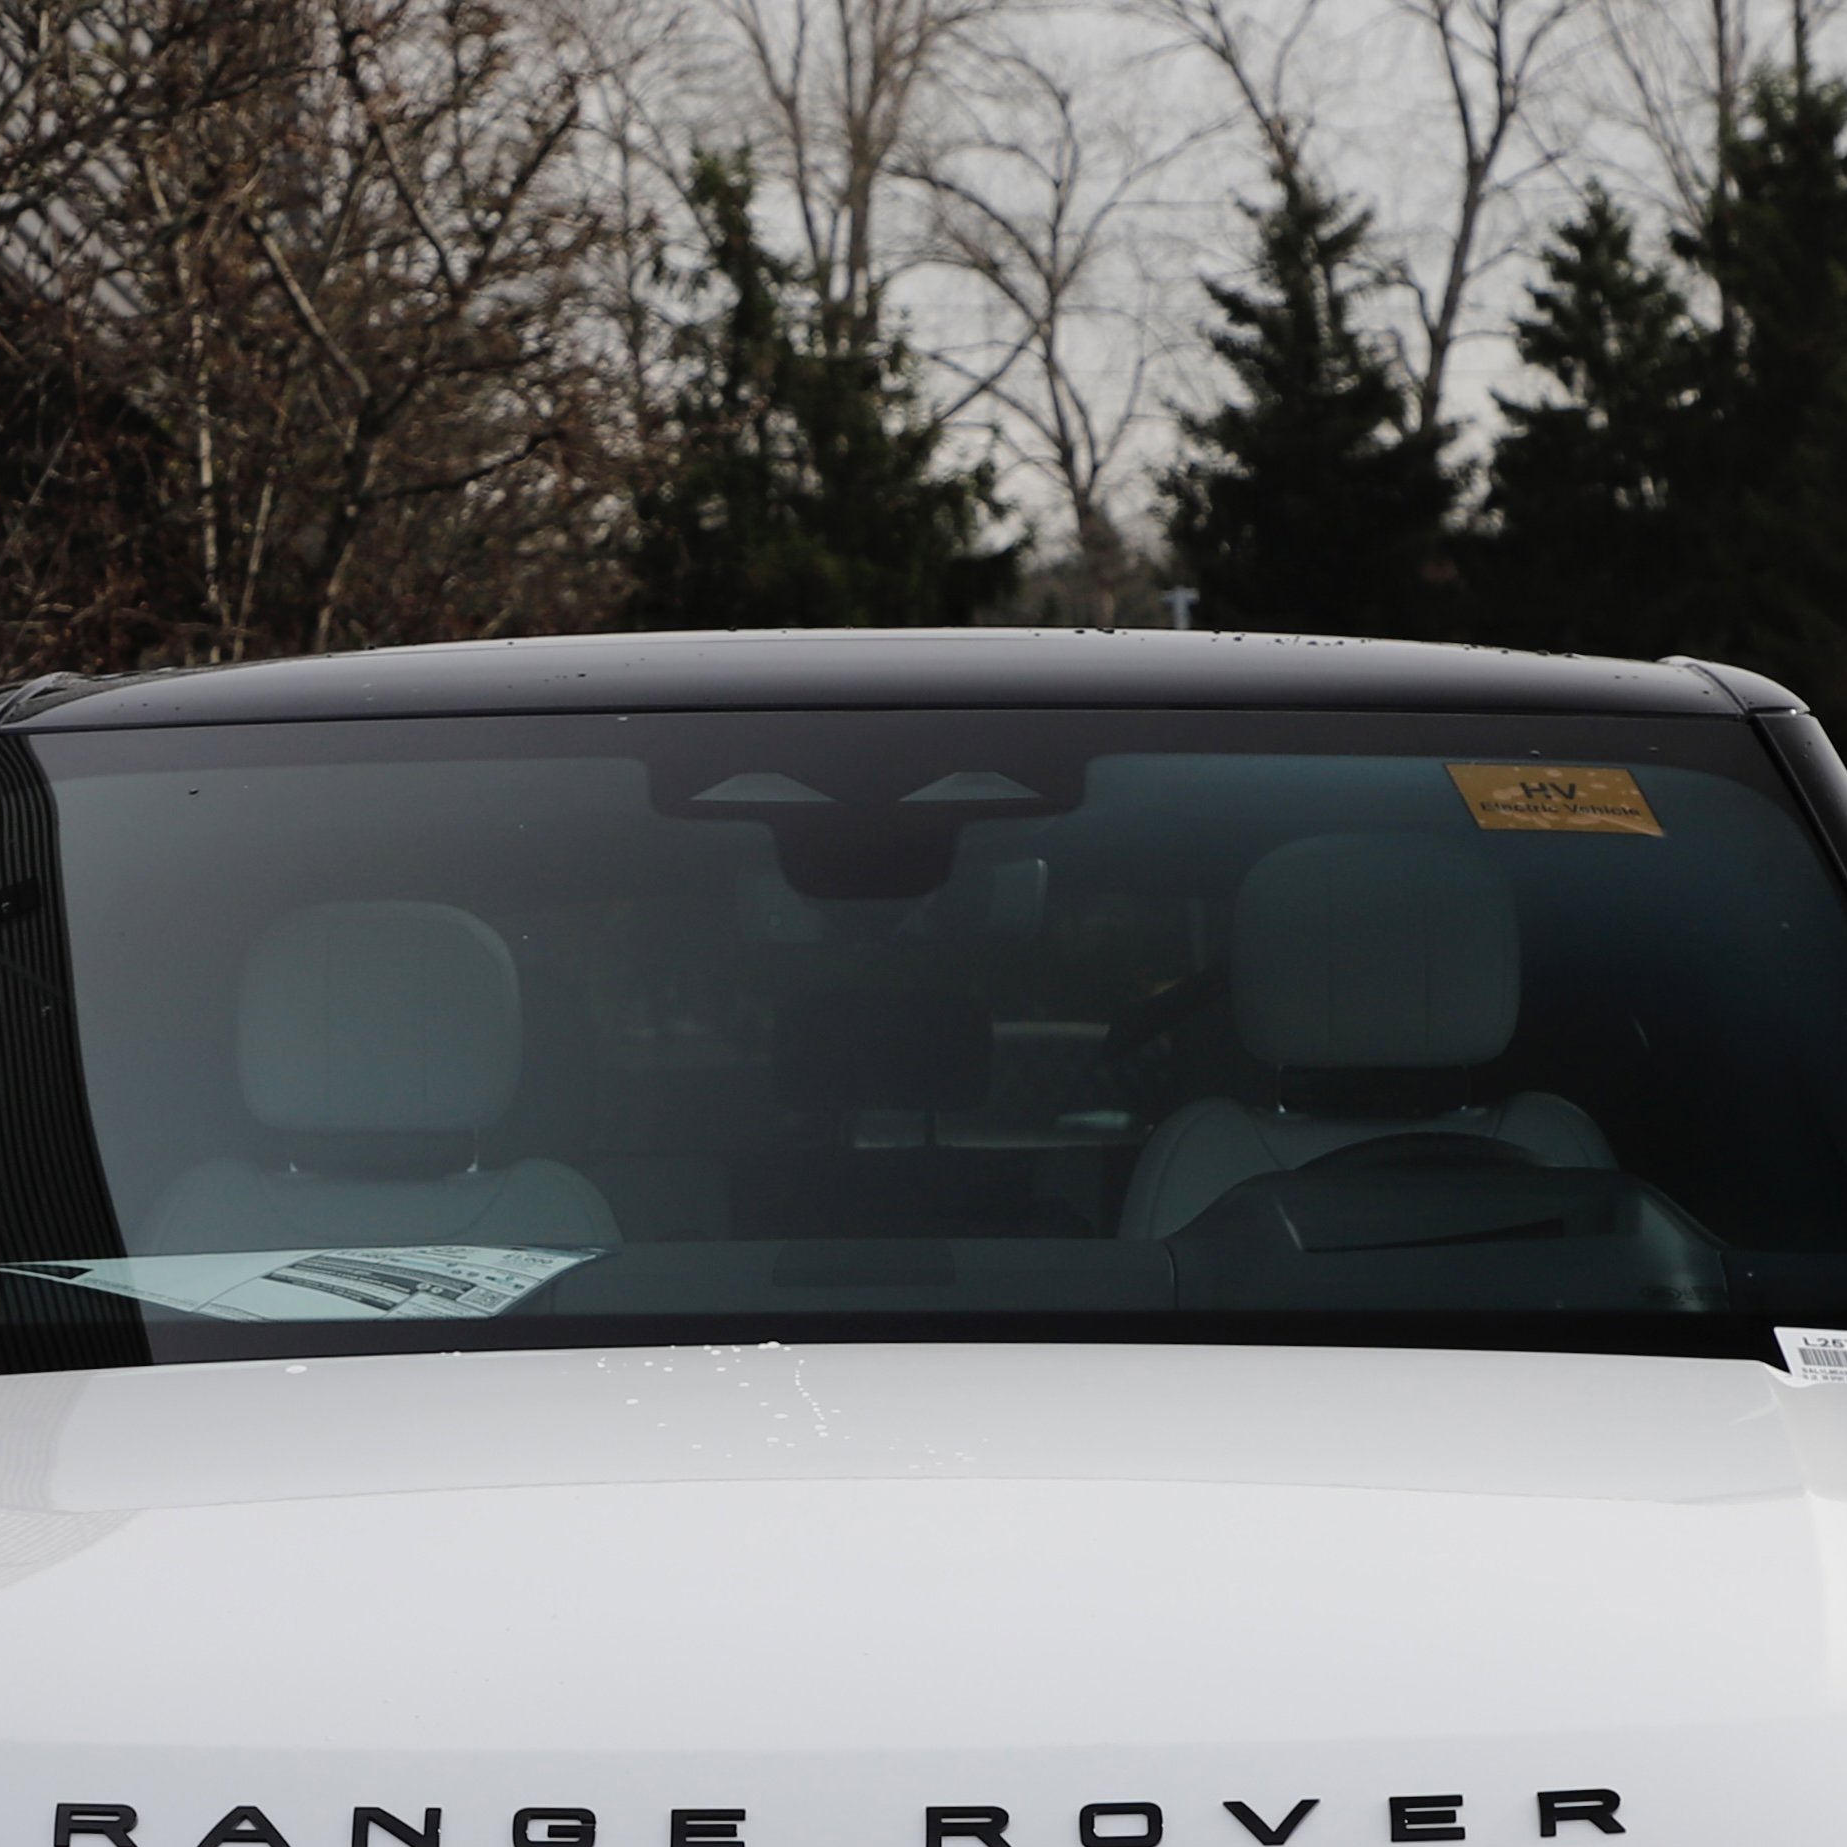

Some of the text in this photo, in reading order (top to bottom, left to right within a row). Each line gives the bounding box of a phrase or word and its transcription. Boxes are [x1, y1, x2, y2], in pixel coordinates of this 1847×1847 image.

[1518, 781, 1578, 801] HV
[1479, 801, 1641, 817] Electric Vehicle
